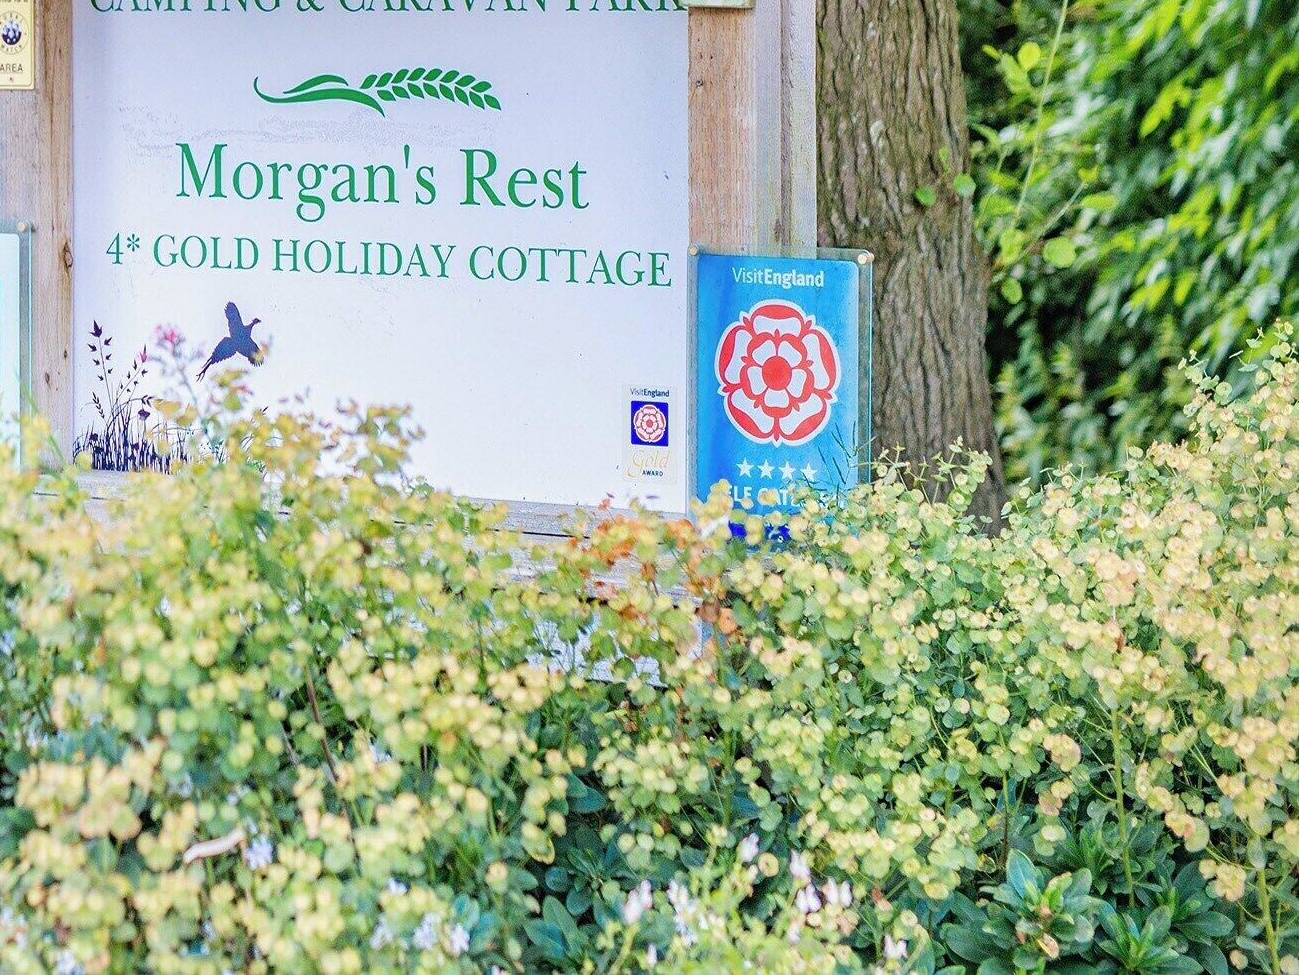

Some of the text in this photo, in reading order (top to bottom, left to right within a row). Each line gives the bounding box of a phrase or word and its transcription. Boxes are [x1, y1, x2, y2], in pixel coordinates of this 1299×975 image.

[0, 64, 23, 73] AREA
[175, 142, 590, 223] Morgan's Rest
[153, 234, 260, 271] GOLD
[272, 238, 457, 278] HOLIDAY
[469, 245, 673, 288] COTTAGE
[731, 266, 825, 289] VisitEngland
